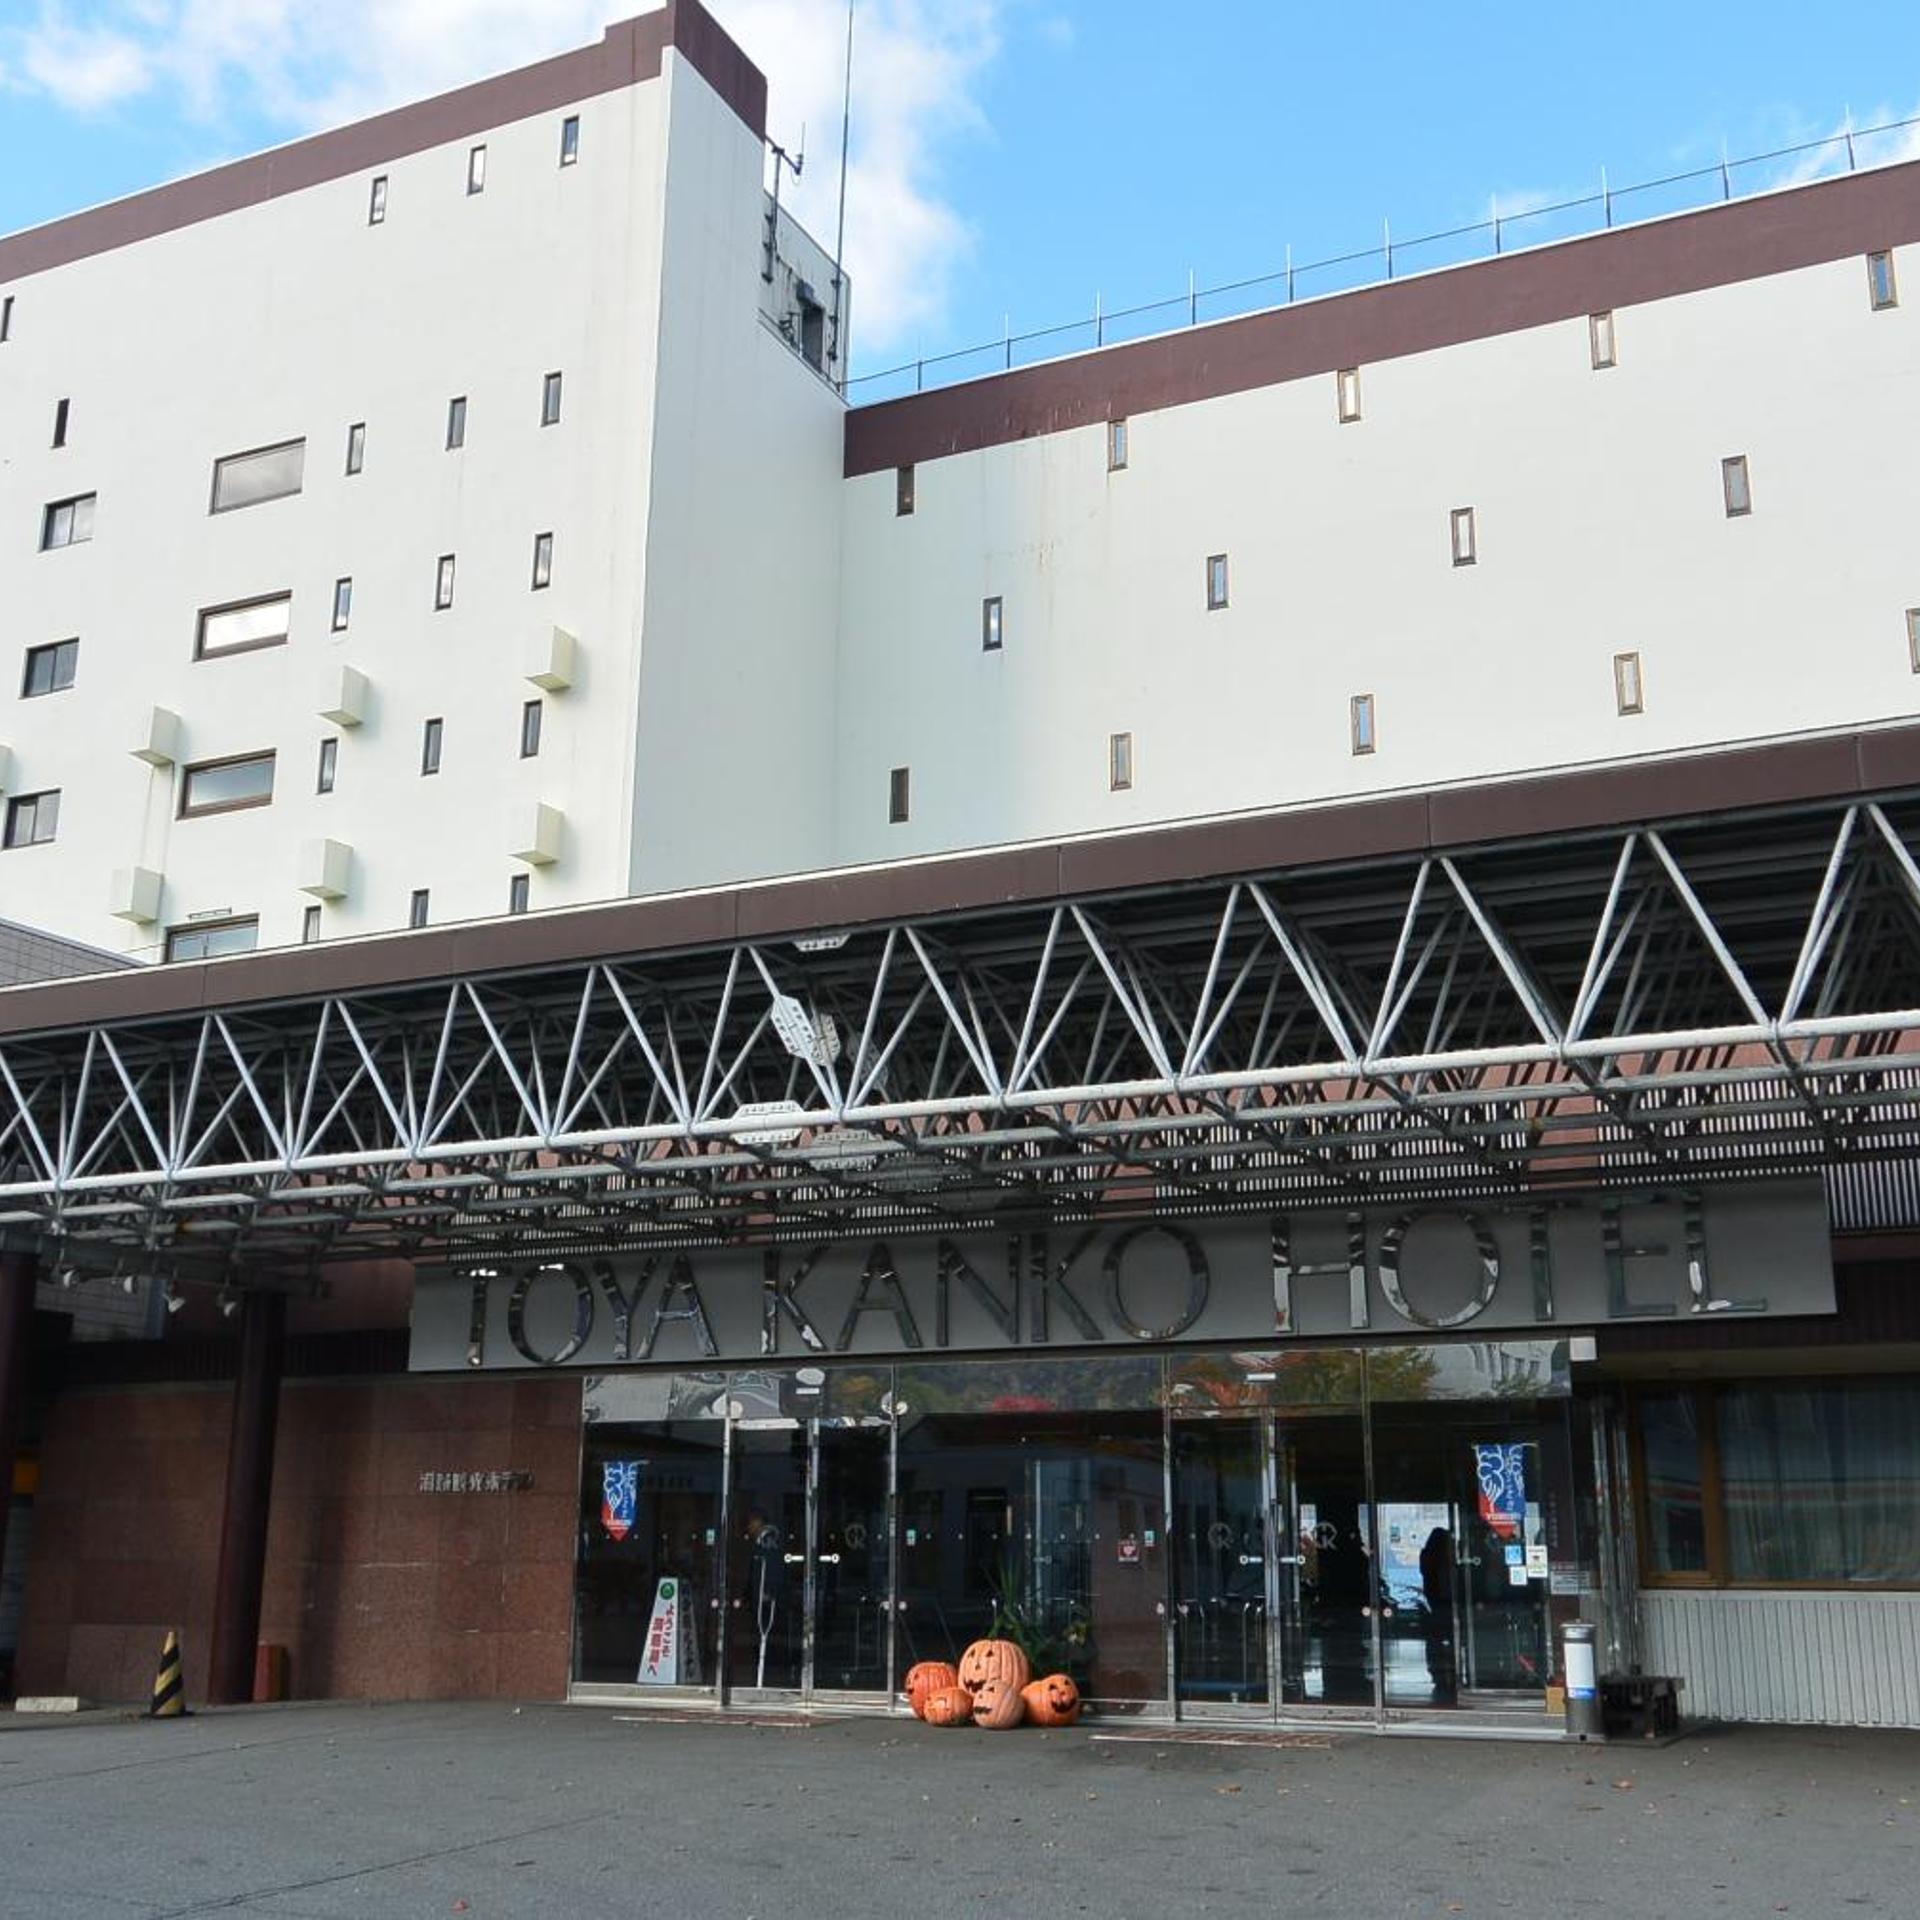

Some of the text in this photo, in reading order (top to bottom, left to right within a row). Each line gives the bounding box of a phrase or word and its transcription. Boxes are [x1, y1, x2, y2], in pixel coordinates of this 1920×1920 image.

[456, 1190, 1768, 1365] TOYA KANKO HOTEL
